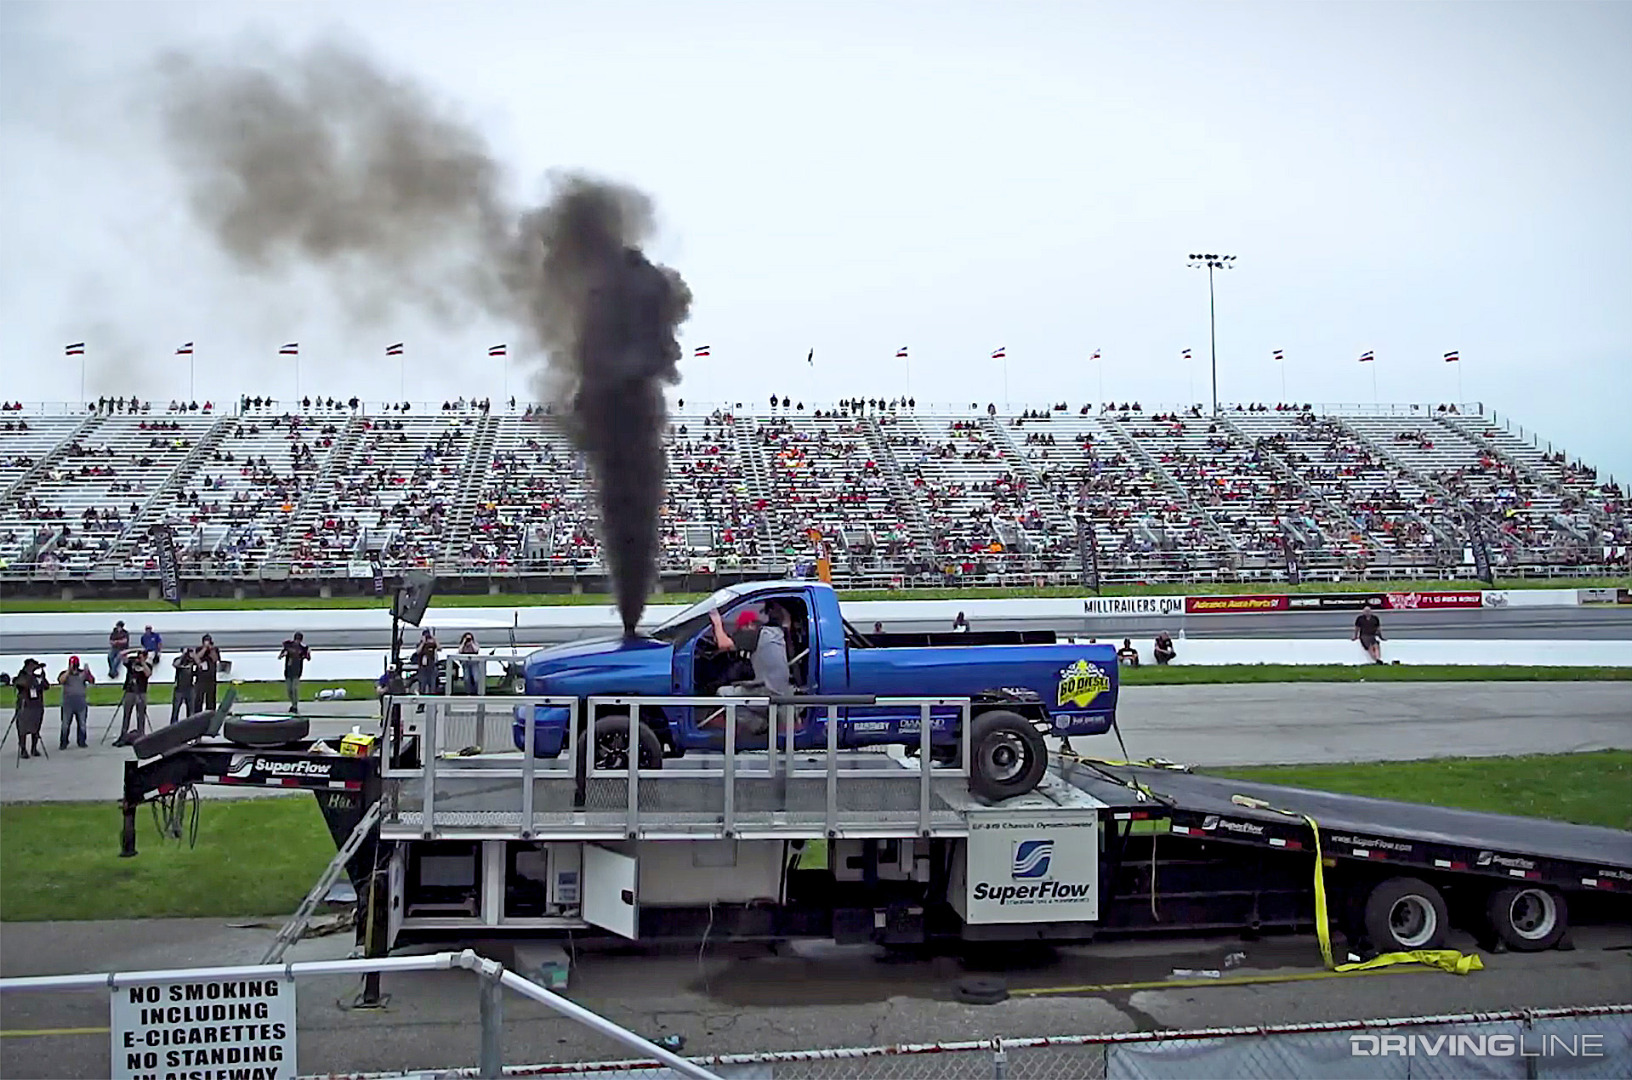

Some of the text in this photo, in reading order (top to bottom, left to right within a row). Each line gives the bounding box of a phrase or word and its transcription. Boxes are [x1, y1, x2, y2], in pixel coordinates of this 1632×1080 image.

[1084, 599, 1182, 615] MILLTRAILERS.COM
[1193, 599, 1271, 609] Advance Auto Parts
[254, 758, 332, 774] SuperFlow
[1219, 818, 1264, 835] SuperFlow
[1331, 835, 1413, 852] www.SuperFlow.com
[973, 881, 1090, 905] SuperFlow
[129, 980, 279, 1004] NO SMOKING
[141, 1002, 268, 1025] INCLUDING
[123, 1023, 286, 1048] E-CIGARETTES
[127, 1045, 283, 1070] NO STANDING
